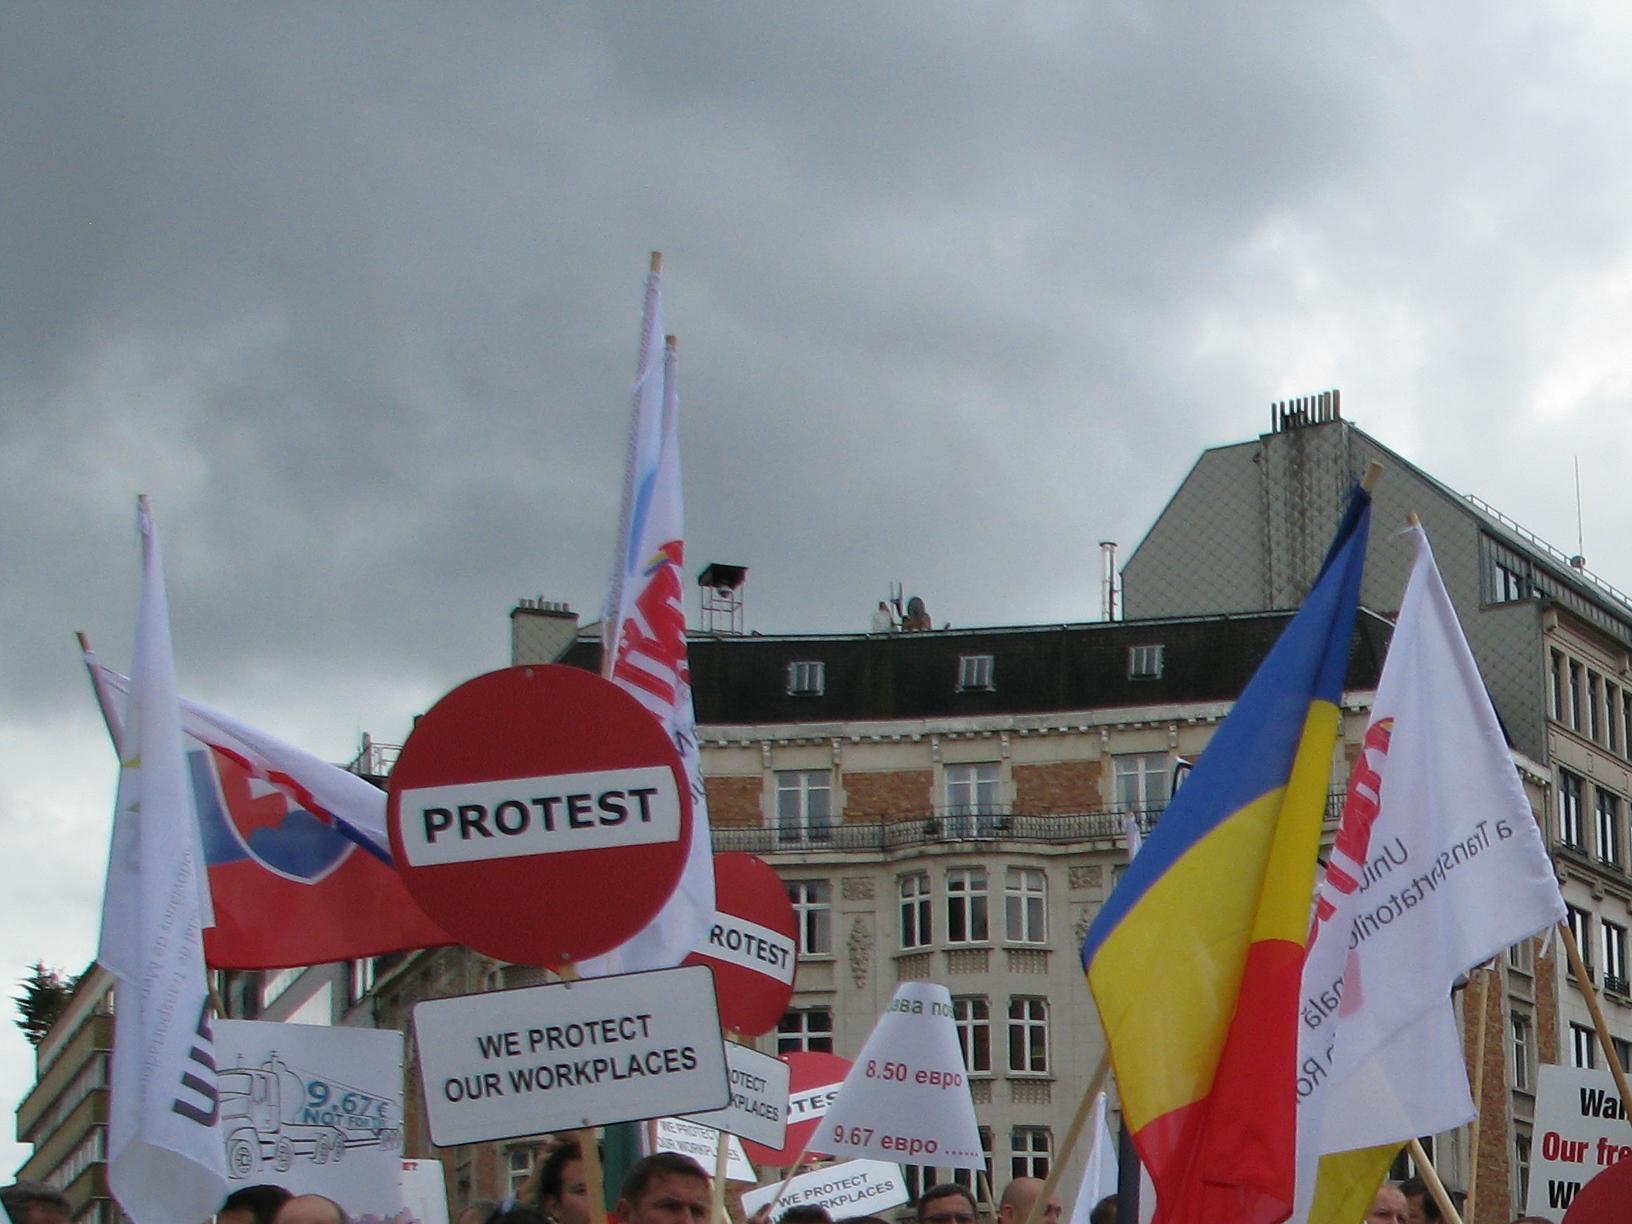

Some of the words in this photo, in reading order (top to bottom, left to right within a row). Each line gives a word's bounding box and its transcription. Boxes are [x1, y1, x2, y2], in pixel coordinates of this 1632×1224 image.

[423, 787, 659, 843] PROTEST
[710, 924, 791, 971] ROTEST
[478, 1032, 520, 1059] WE
[528, 1014, 652, 1052] PROTECT
[444, 1071, 503, 1102] OUR
[509, 1047, 697, 1092] WORKPLACES
[729, 1069, 767, 1093] OTECT
[866, 1060, 907, 1082] 8.50
[915, 1070, 962, 1090] евро
[307, 1080, 370, 1114] 9.67
[303, 1108, 344, 1126] NOT
[833, 1129, 873, 1148] 9.67
[881, 1134, 938, 1157] евро
[1542, 1131, 1589, 1164] Our
[778, 1194, 802, 1209] WE
[804, 1174, 869, 1202] PROTECT
